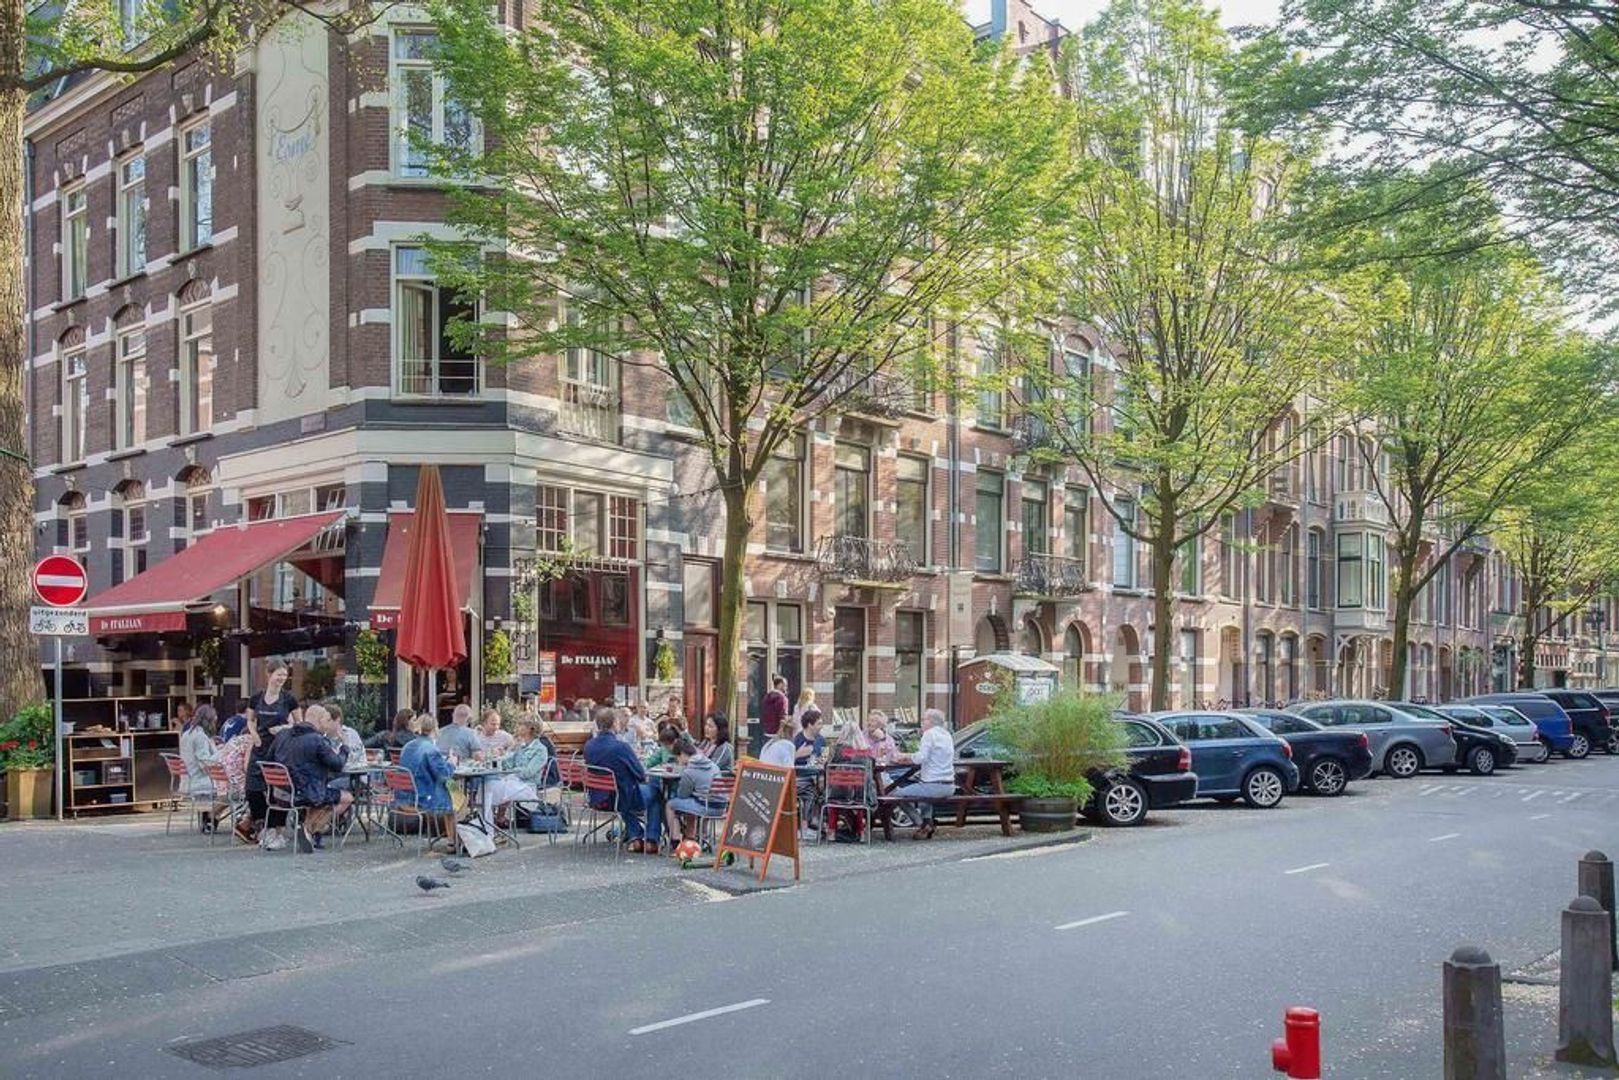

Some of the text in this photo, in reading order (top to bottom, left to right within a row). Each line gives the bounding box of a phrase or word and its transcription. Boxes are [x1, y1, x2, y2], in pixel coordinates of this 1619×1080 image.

[101, 618, 142, 630] De ITALIAAN
[377, 614, 393, 623] De
[561, 655, 617, 665] De ITALIAAN
[752, 771, 786, 783] ITALIAAN
